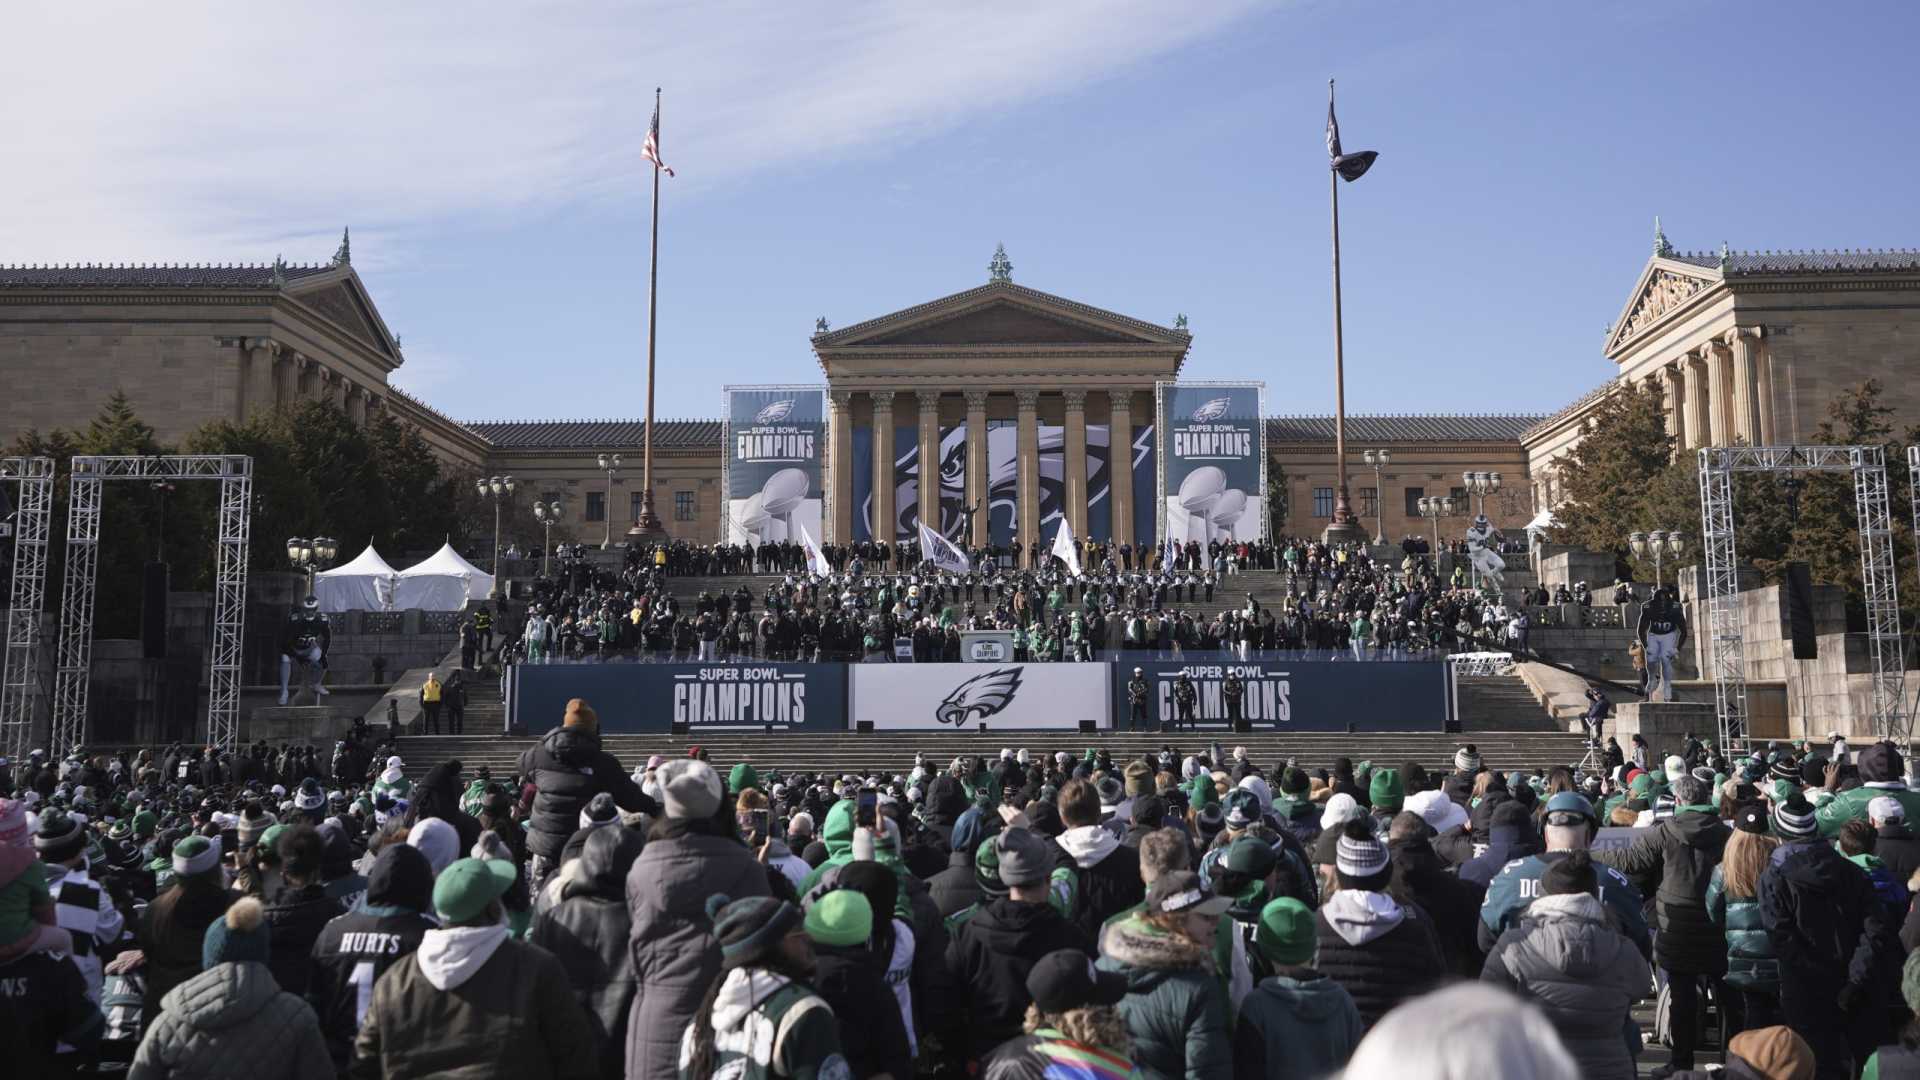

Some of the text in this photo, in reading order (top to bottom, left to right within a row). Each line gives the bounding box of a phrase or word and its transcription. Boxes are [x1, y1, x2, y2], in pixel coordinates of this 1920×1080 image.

[751, 426, 799, 434] SUPER BOWL
[1188, 424, 1236, 432] SUPER BOWL
[737, 434, 814, 459] CHAMPIONS
[1174, 432, 1251, 457] CHAMPIONS
[699, 667, 780, 680] SUPER BOWL
[1182, 666, 1223, 679] SUPER
[674, 682, 805, 723] CHAMPIONS
[1158, 680, 1291, 721] CAMIONS
[339, 932, 401, 954] HURTS
[347, 962, 375, 1030] 1
